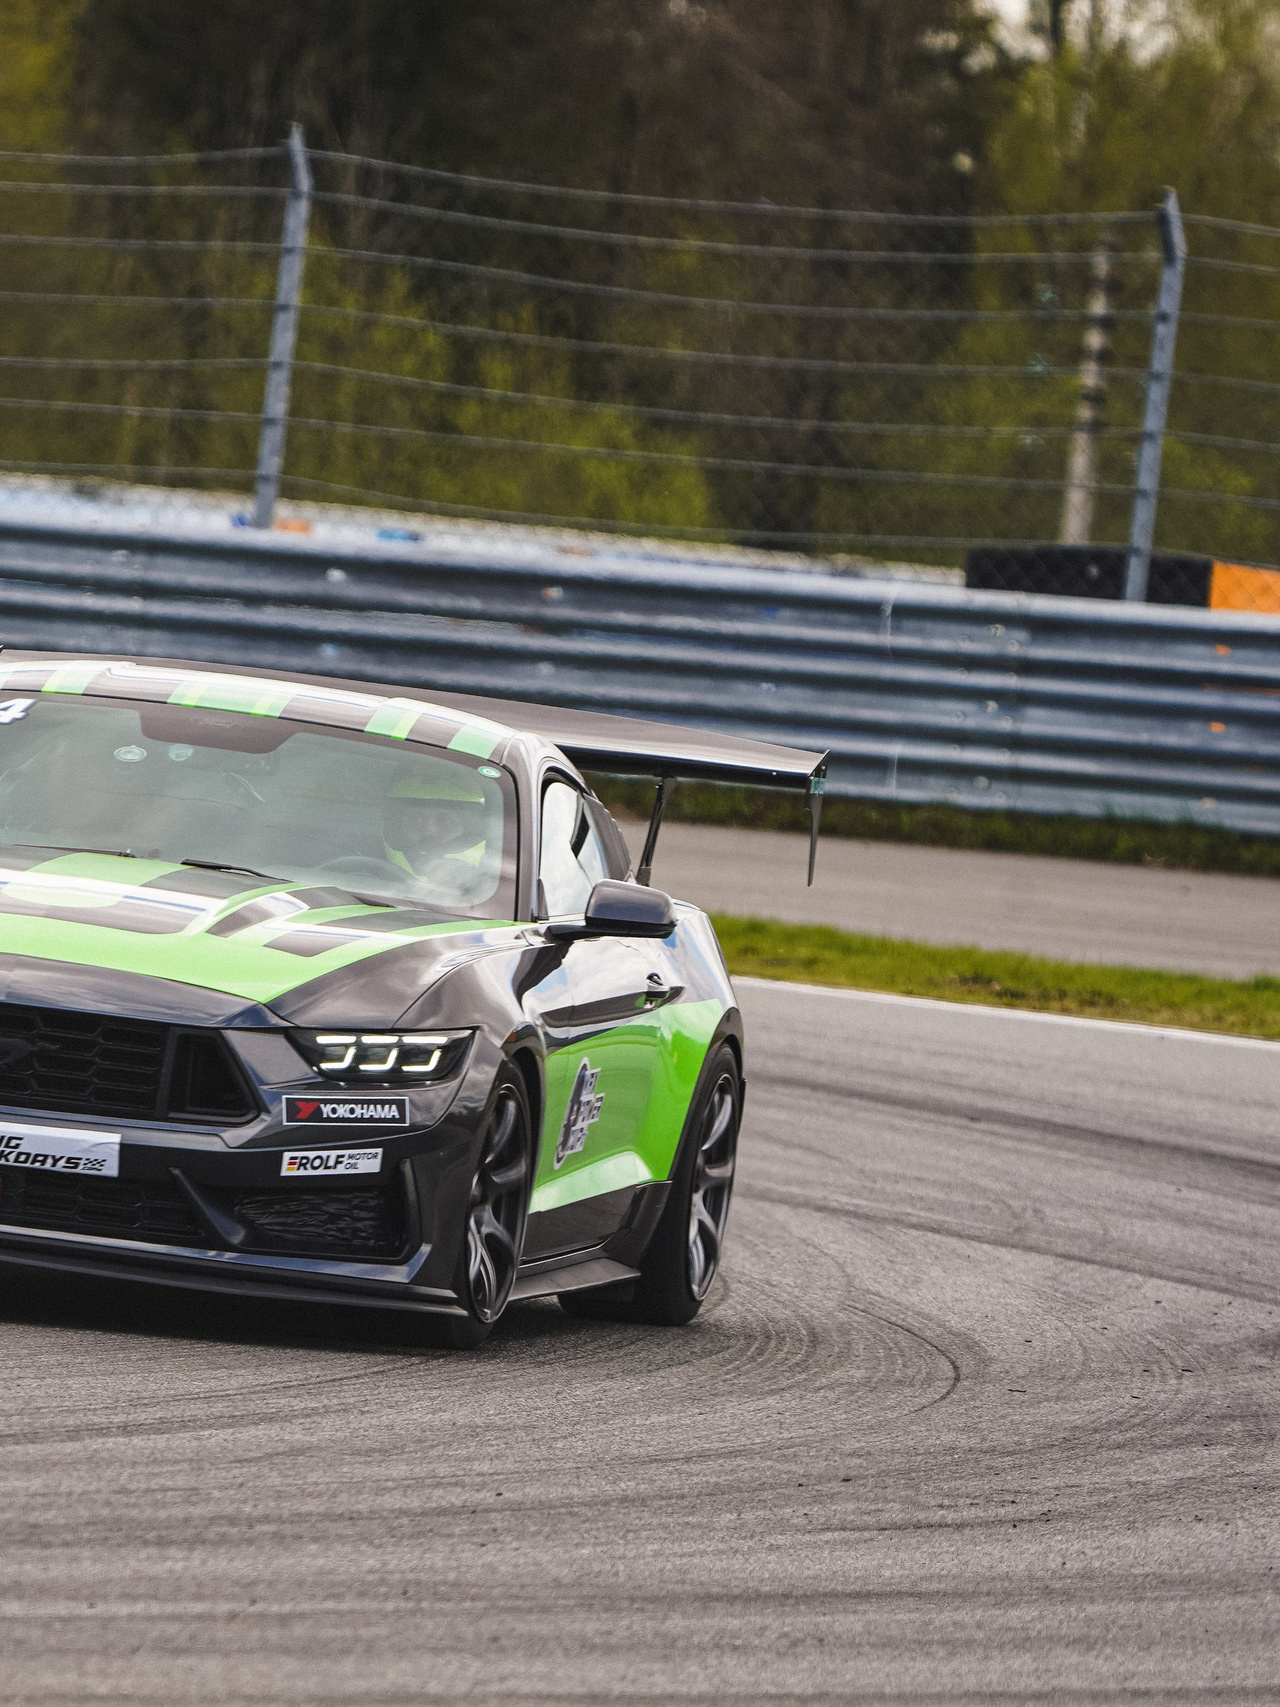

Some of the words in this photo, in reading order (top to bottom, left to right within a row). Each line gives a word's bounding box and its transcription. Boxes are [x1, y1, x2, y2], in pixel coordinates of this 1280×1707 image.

[320, 1103, 400, 1119] YOKOHAMA
[297, 1154, 345, 1171] ROLF
[347, 1152, 379, 1160] MOTOR
[344, 1162, 359, 1170] OIL
